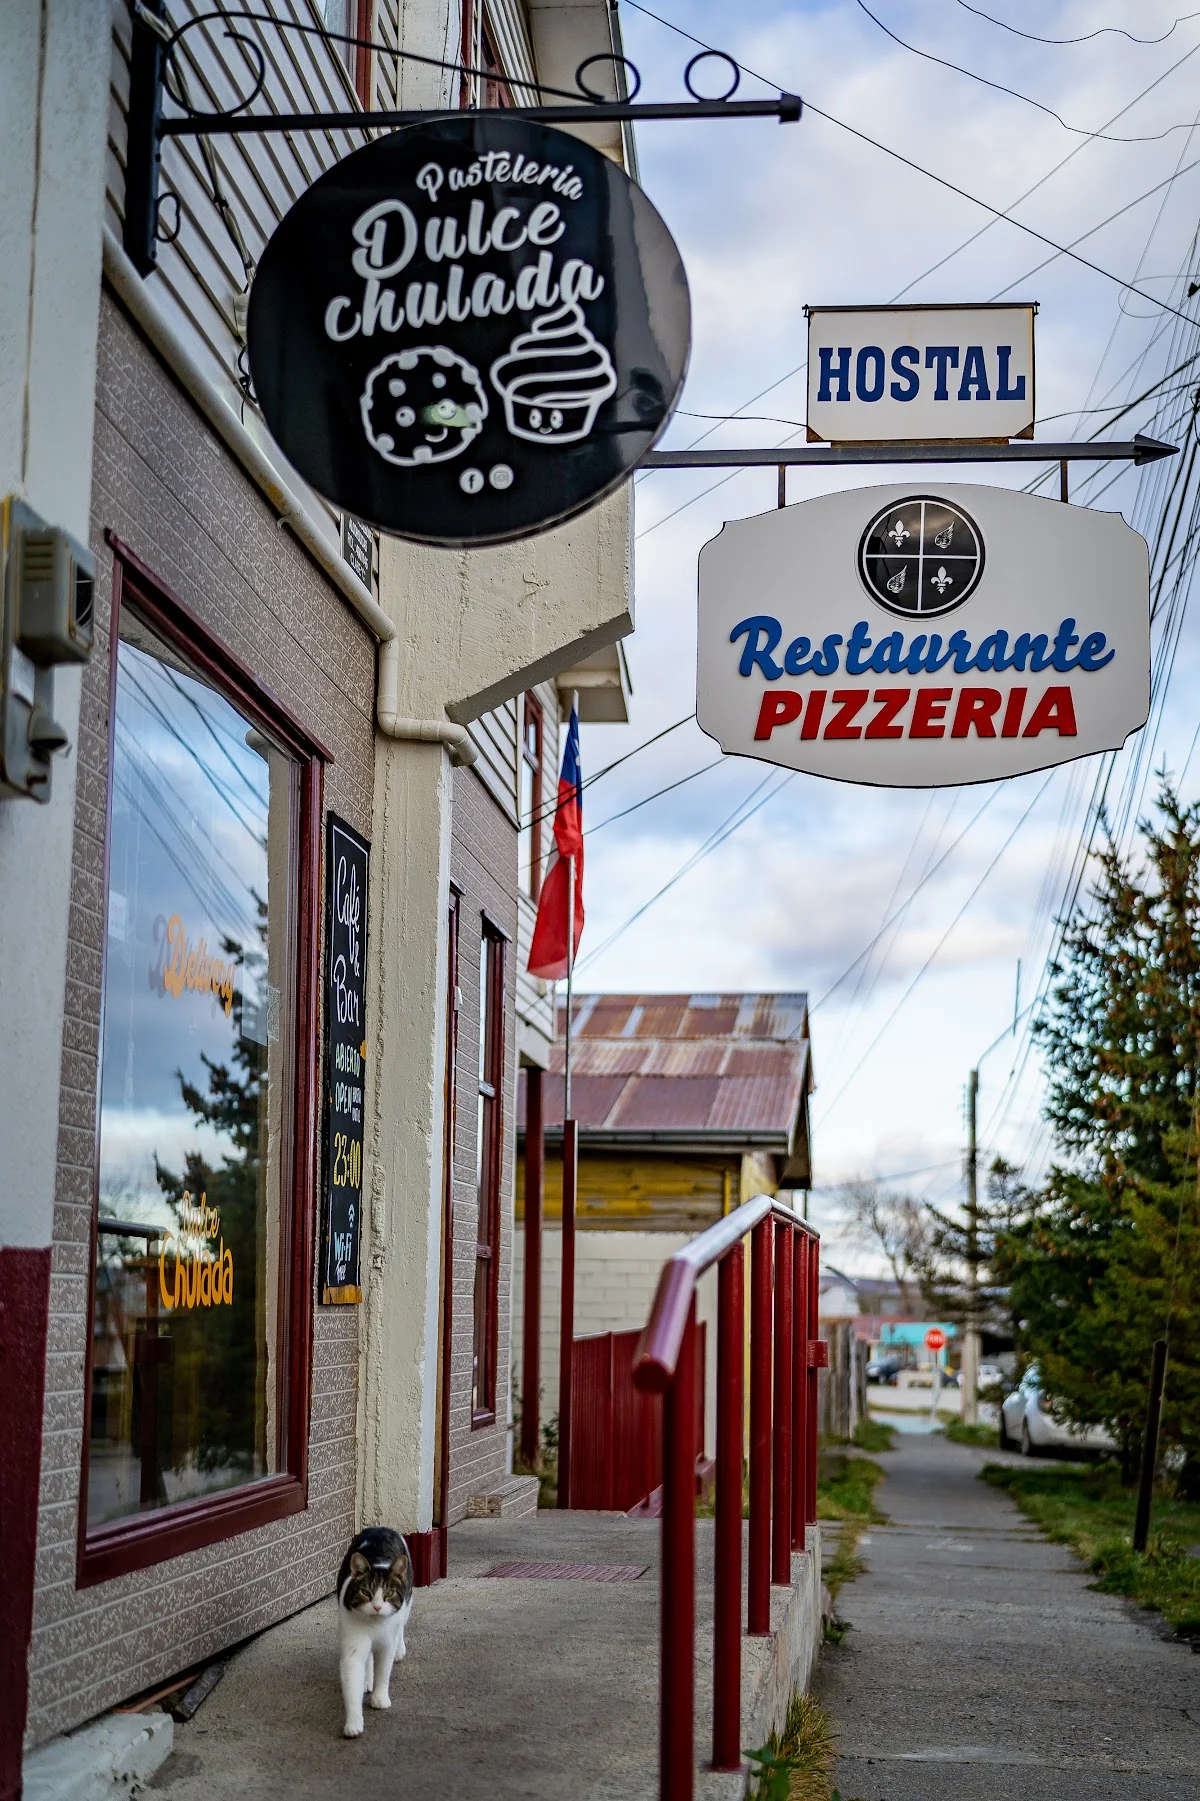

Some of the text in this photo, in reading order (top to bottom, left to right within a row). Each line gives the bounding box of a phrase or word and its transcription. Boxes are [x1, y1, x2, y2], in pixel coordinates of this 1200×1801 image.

[416, 151, 585, 202] Pasteleria
[351, 198, 566, 280] Dulce
[324, 250, 605, 342] chulada
[817, 345, 1026, 402] HOSTAL
[729, 615, 1116, 681] Restaurante
[753, 686, 1078, 741] PIZZERIA
[337, 855, 360, 964] Café
[163, 912, 237, 1019] Delivery
[333, 954, 360, 1027] Bar
[335, 1042, 361, 1078] ABIERTO
[335, 1081, 352, 1114] OPEN
[333, 1131, 361, 1189] 23:00
[181, 1190, 220, 1243] Dulce
[159, 1230, 234, 1310] Chulada
